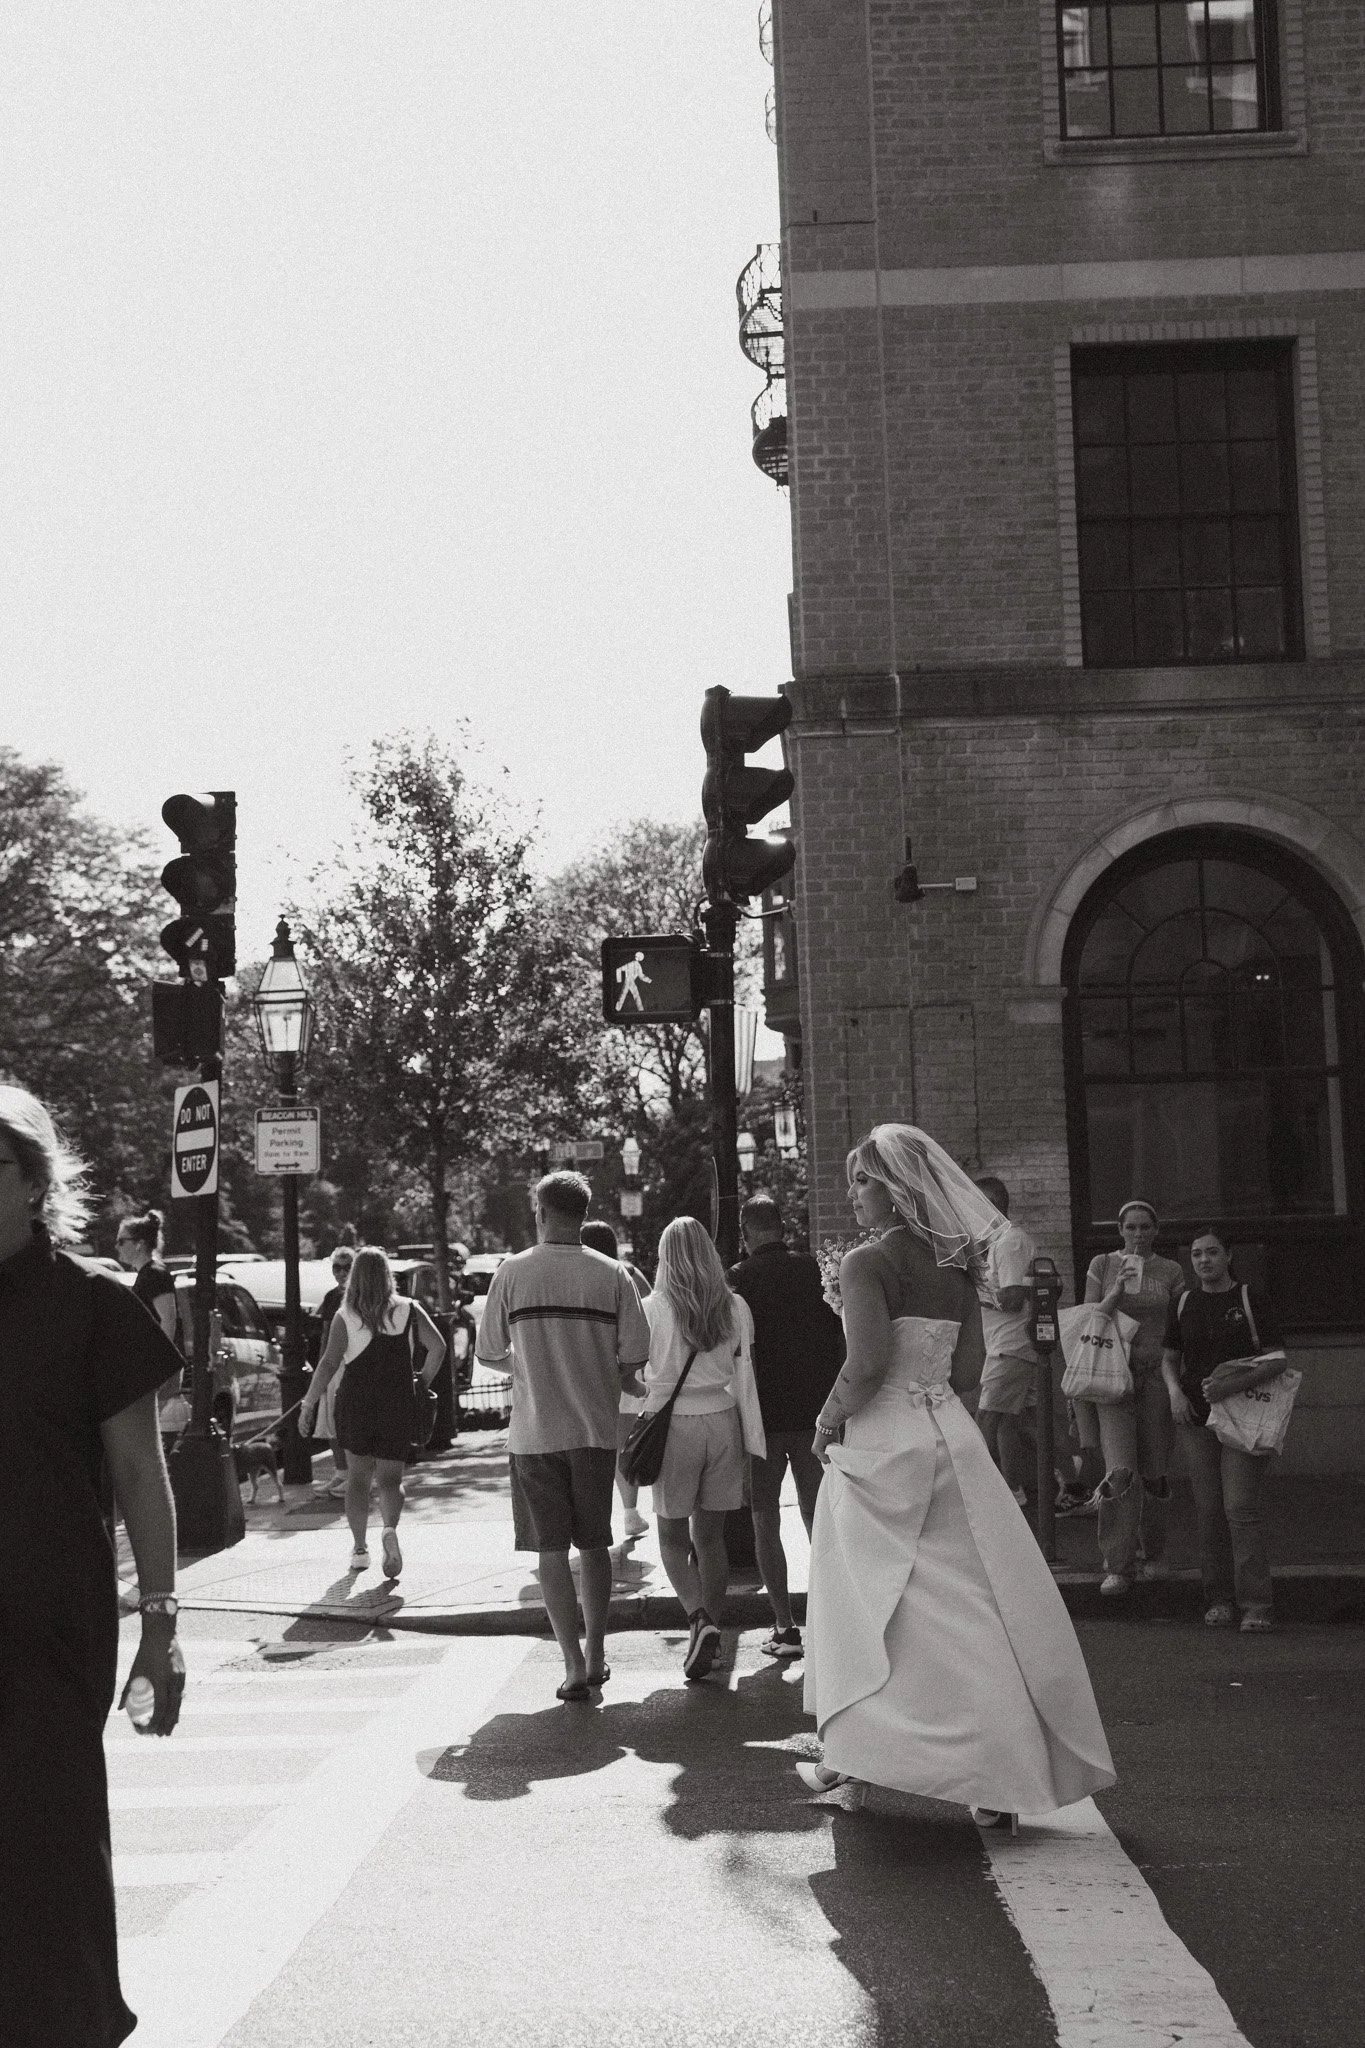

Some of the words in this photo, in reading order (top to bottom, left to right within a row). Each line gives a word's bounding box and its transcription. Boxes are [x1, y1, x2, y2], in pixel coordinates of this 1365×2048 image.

[180, 1108, 192, 1125] DO
[195, 1104, 211, 1122] NOT
[271, 1126, 301, 1136] Permit
[269, 1138, 304, 1149] Parking
[181, 1154, 207, 1174] ENTER
[1091, 1335, 1114, 1349] CVS
[1245, 1386, 1272, 1403] CVS
